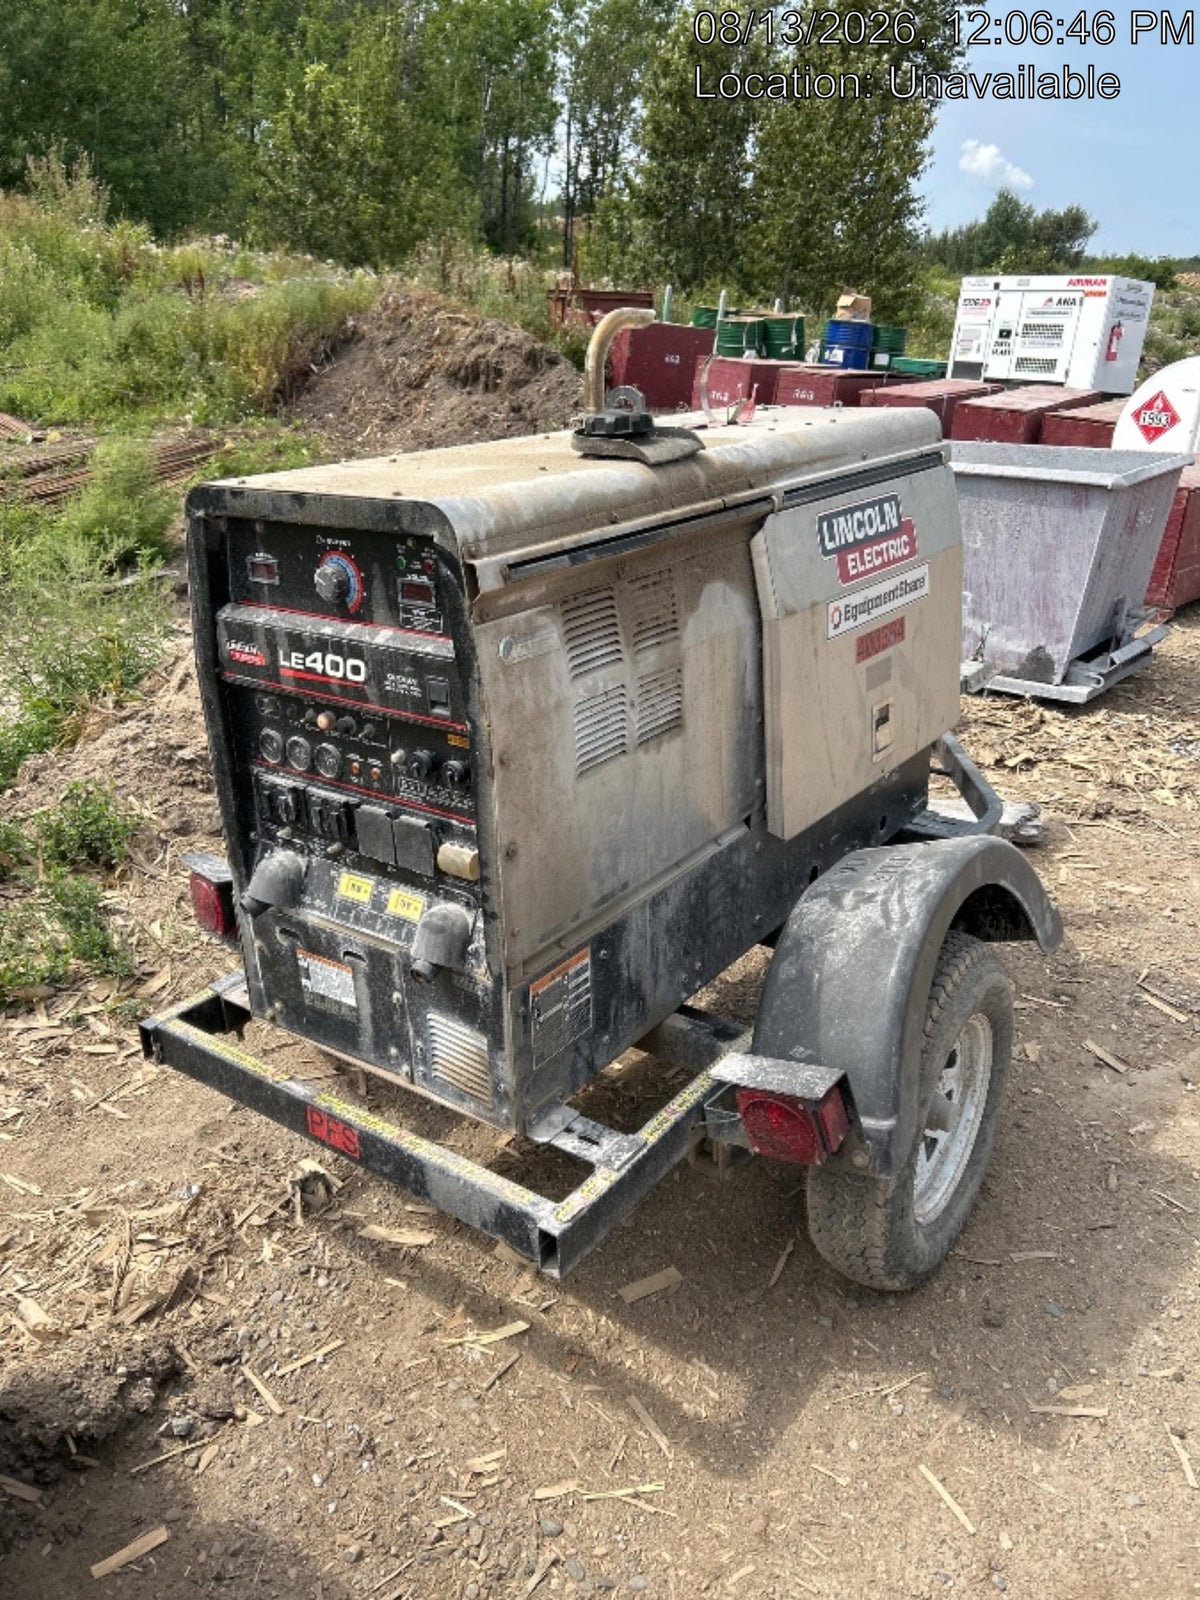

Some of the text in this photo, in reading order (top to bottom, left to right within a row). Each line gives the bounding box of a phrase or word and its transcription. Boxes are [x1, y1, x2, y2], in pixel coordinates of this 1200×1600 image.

[823, 500, 899, 550] LINCOLN
[847, 534, 910, 576] ELECTRIC
[844, 579, 926, 622] EquipmentShare
[279, 649, 366, 682] LE400
